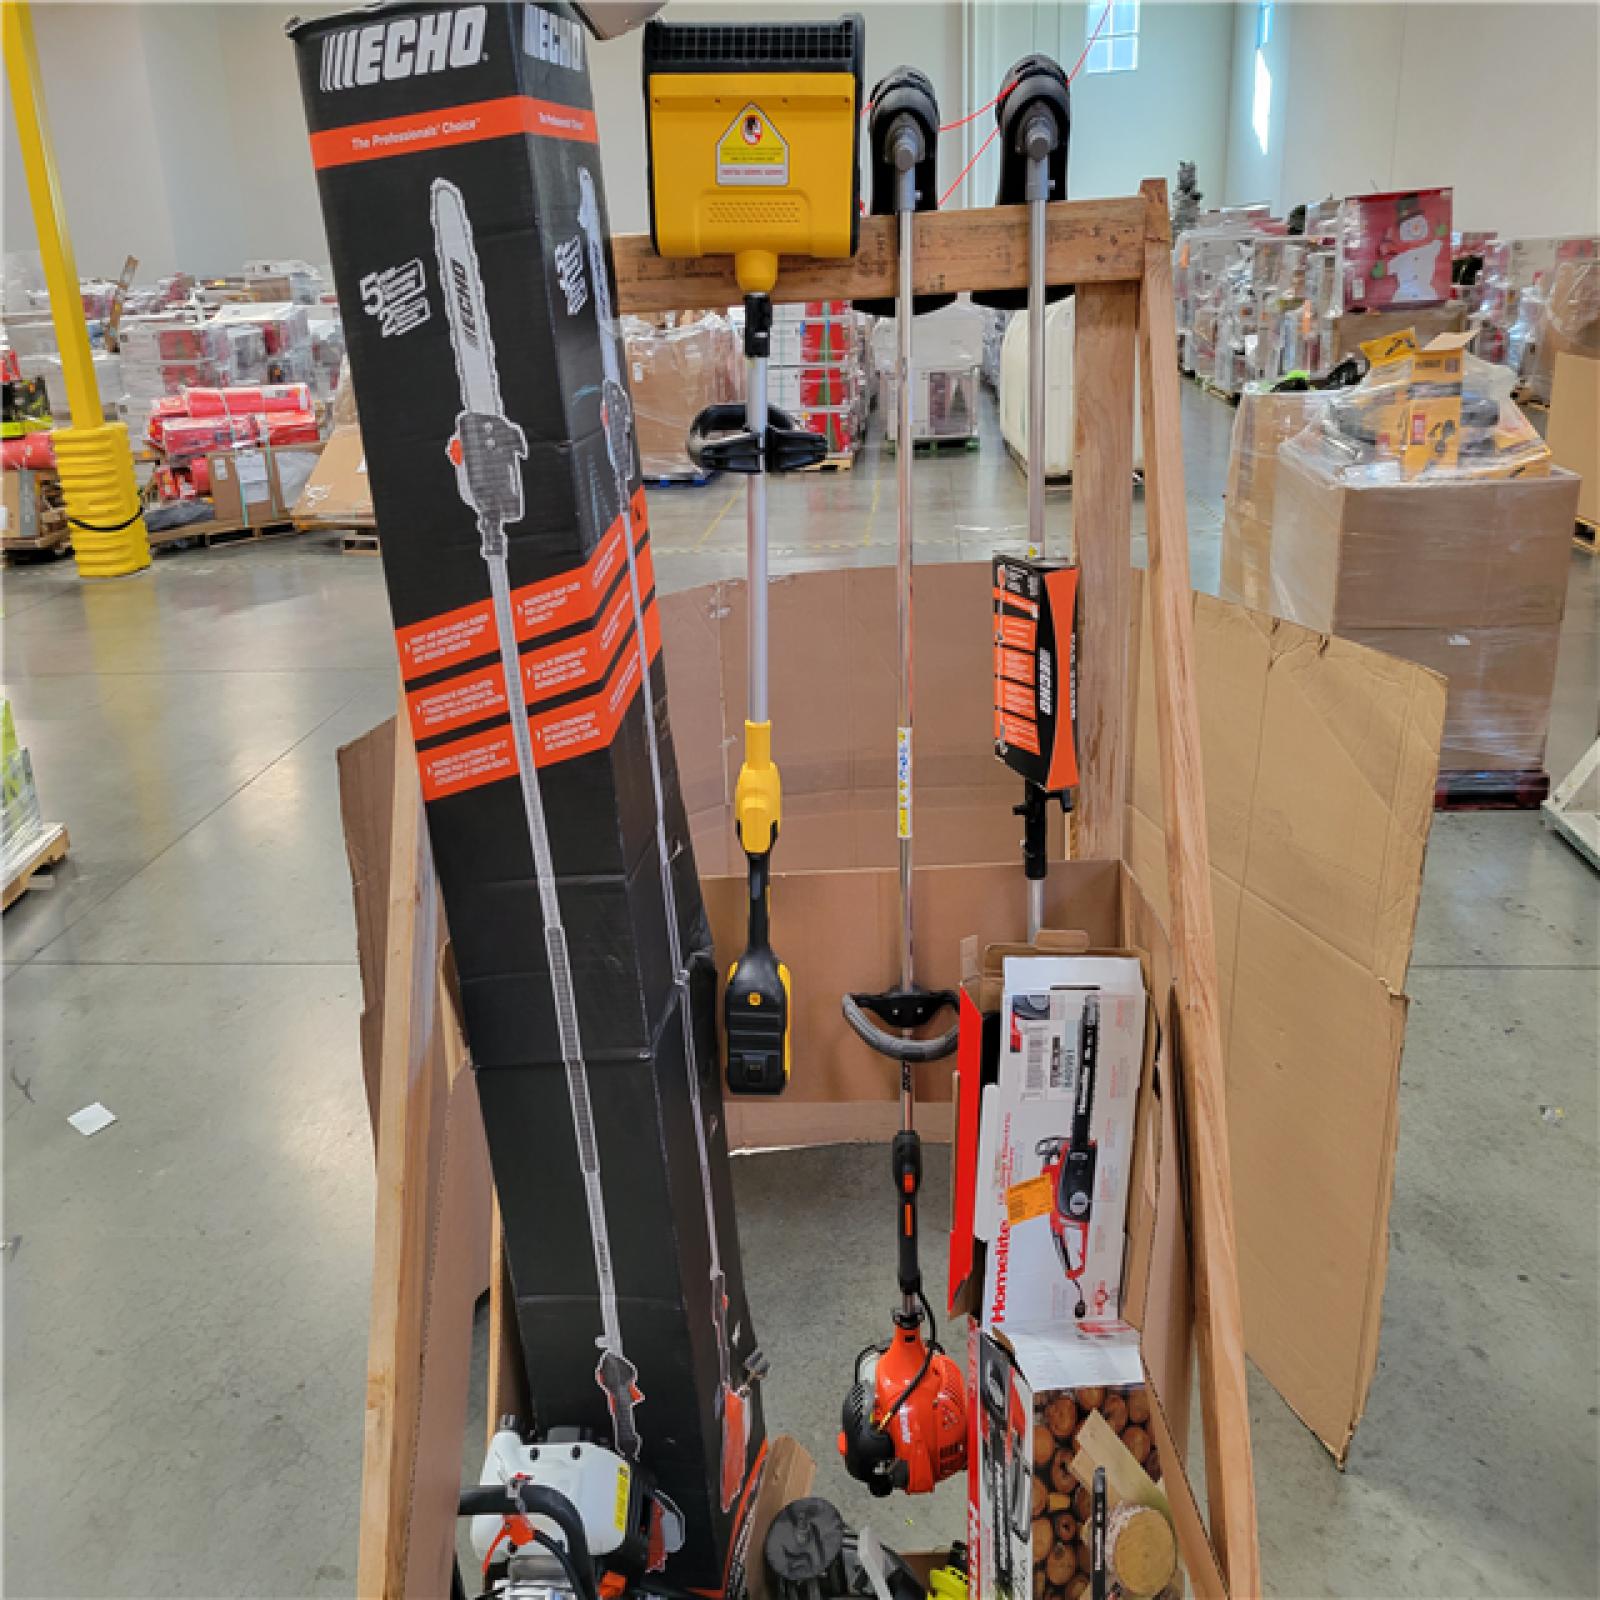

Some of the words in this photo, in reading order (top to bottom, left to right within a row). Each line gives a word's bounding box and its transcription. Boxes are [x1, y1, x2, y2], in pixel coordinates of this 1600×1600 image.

[354, 5, 487, 86] ECHO
[538, 8, 583, 72] ECHO
[989, 1219, 1011, 1324] Homelite
